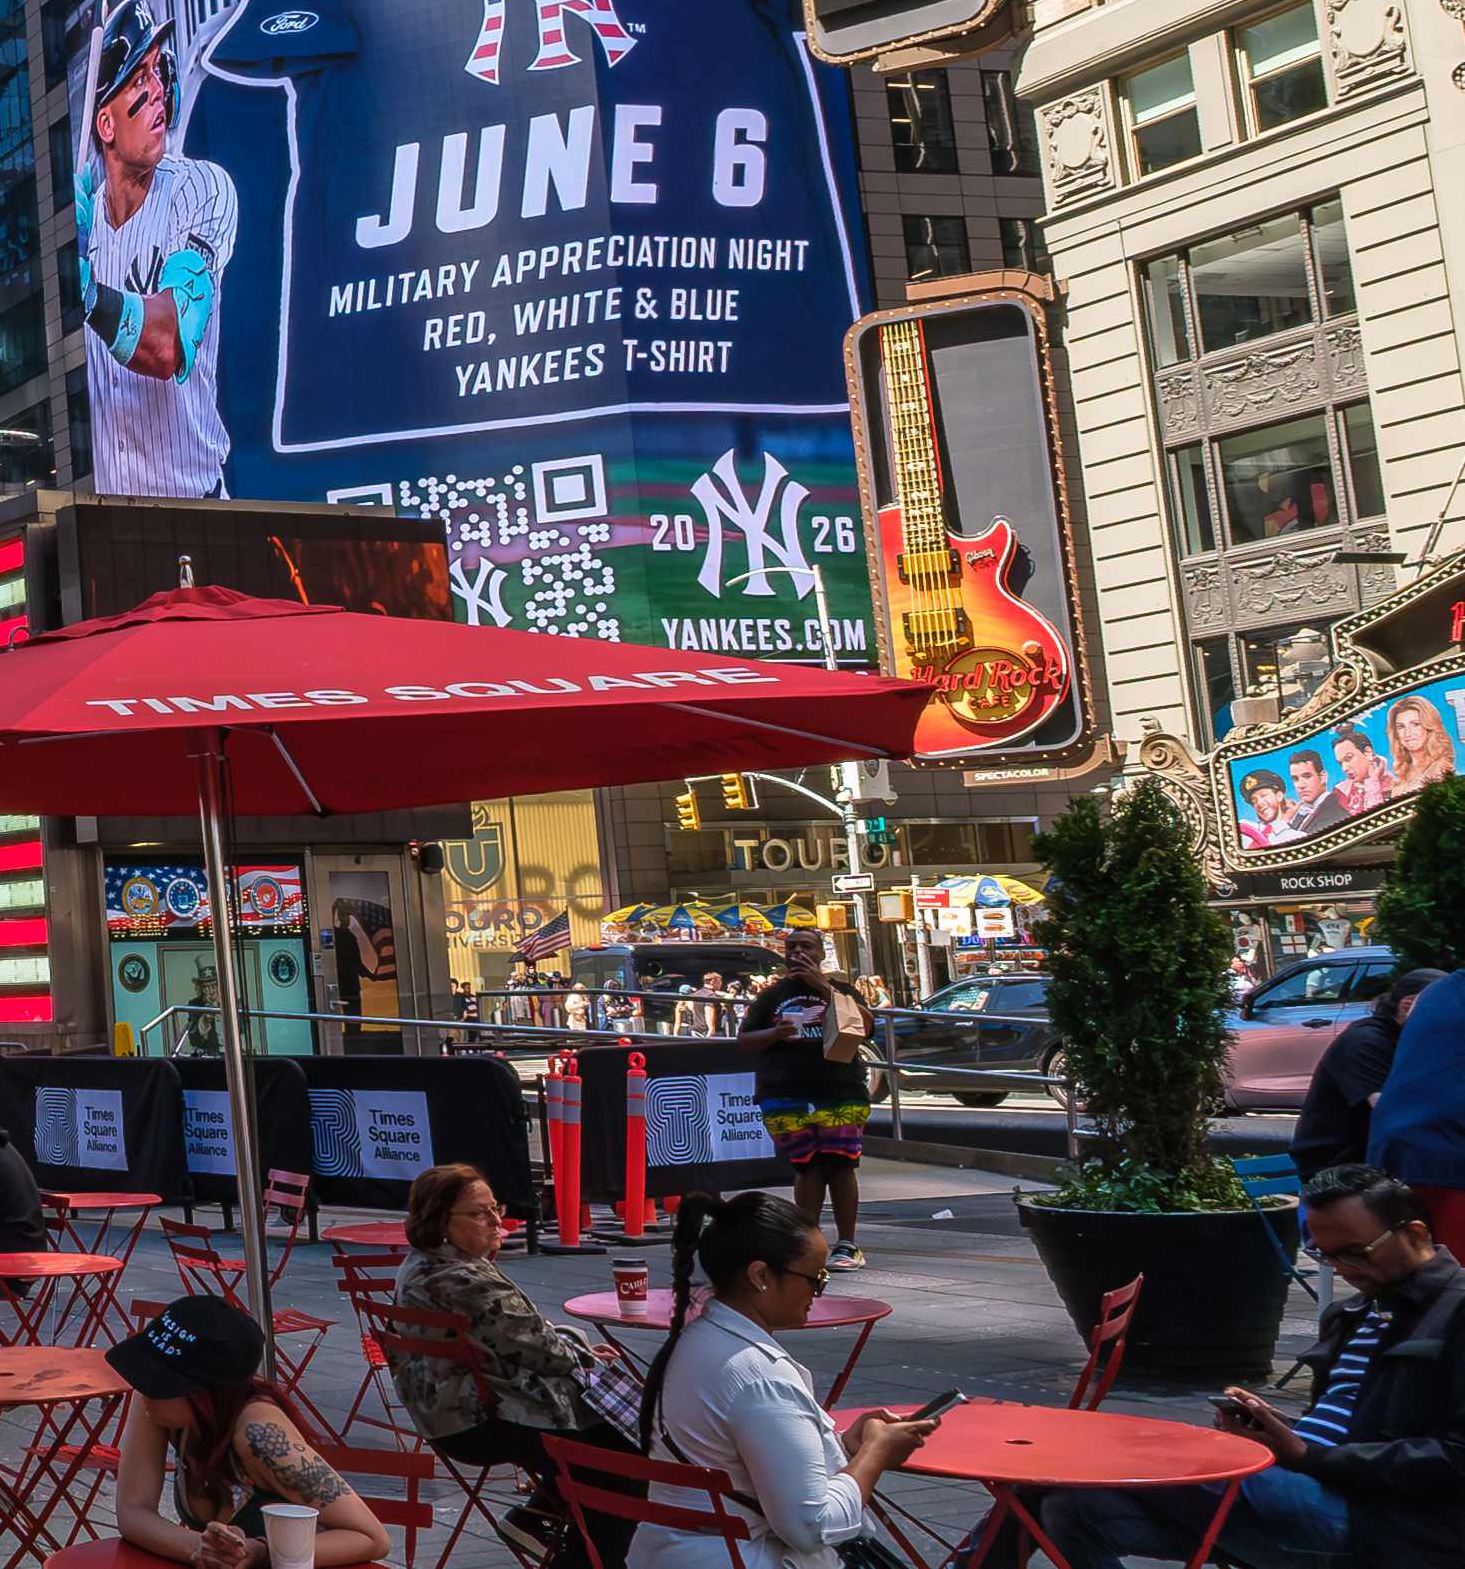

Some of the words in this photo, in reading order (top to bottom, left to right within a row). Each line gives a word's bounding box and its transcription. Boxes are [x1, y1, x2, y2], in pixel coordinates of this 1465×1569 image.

[268, 13, 311, 33] Ford
[354, 104, 663, 250] JUNE
[713, 107, 768, 208] 6
[327, 259, 483, 318] MILITARY
[491, 235, 717, 288] APPRECIATION
[727, 238, 810, 273] NIGHT
[423, 308, 496, 352] RED,
[513, 287, 624, 337] WHITE
[635, 287, 659, 320] &
[670, 287, 740, 323] BLUE
[454, 341, 606, 398] YANKEES
[622, 340, 734, 375] T-SHIRT
[650, 513, 696, 551] 20
[813, 515, 857, 553] 26
[662, 619, 866, 652] YANKEES.COM
[910, 659, 982, 693] Hard
[990, 657, 1063, 695] Rock
[85, 689, 369, 718] TIMES
[384, 666, 782, 703] SQUARE
[968, 694, 1011, 710] CAFE
[974, 768, 1049, 781] SPECTACOLOR
[734, 836, 890, 871] TOURO
[1280, 875, 1314, 890] ROCK
[1316, 873, 1352, 888] SHOP
[718, 1091, 755, 1107] Time
[84, 1107, 115, 1124] Times
[184, 1107, 225, 1125] Times
[368, 1108, 415, 1127] Times
[717, 1108, 763, 1128] Square
[83, 1122, 118, 1141] Square
[368, 1125, 421, 1146] Square
[719, 1127, 763, 1143] Alliance
[85, 1139, 118, 1155] Alliance
[187, 1141, 228, 1157] Alliance
[374, 1145, 421, 1162] Alliance
